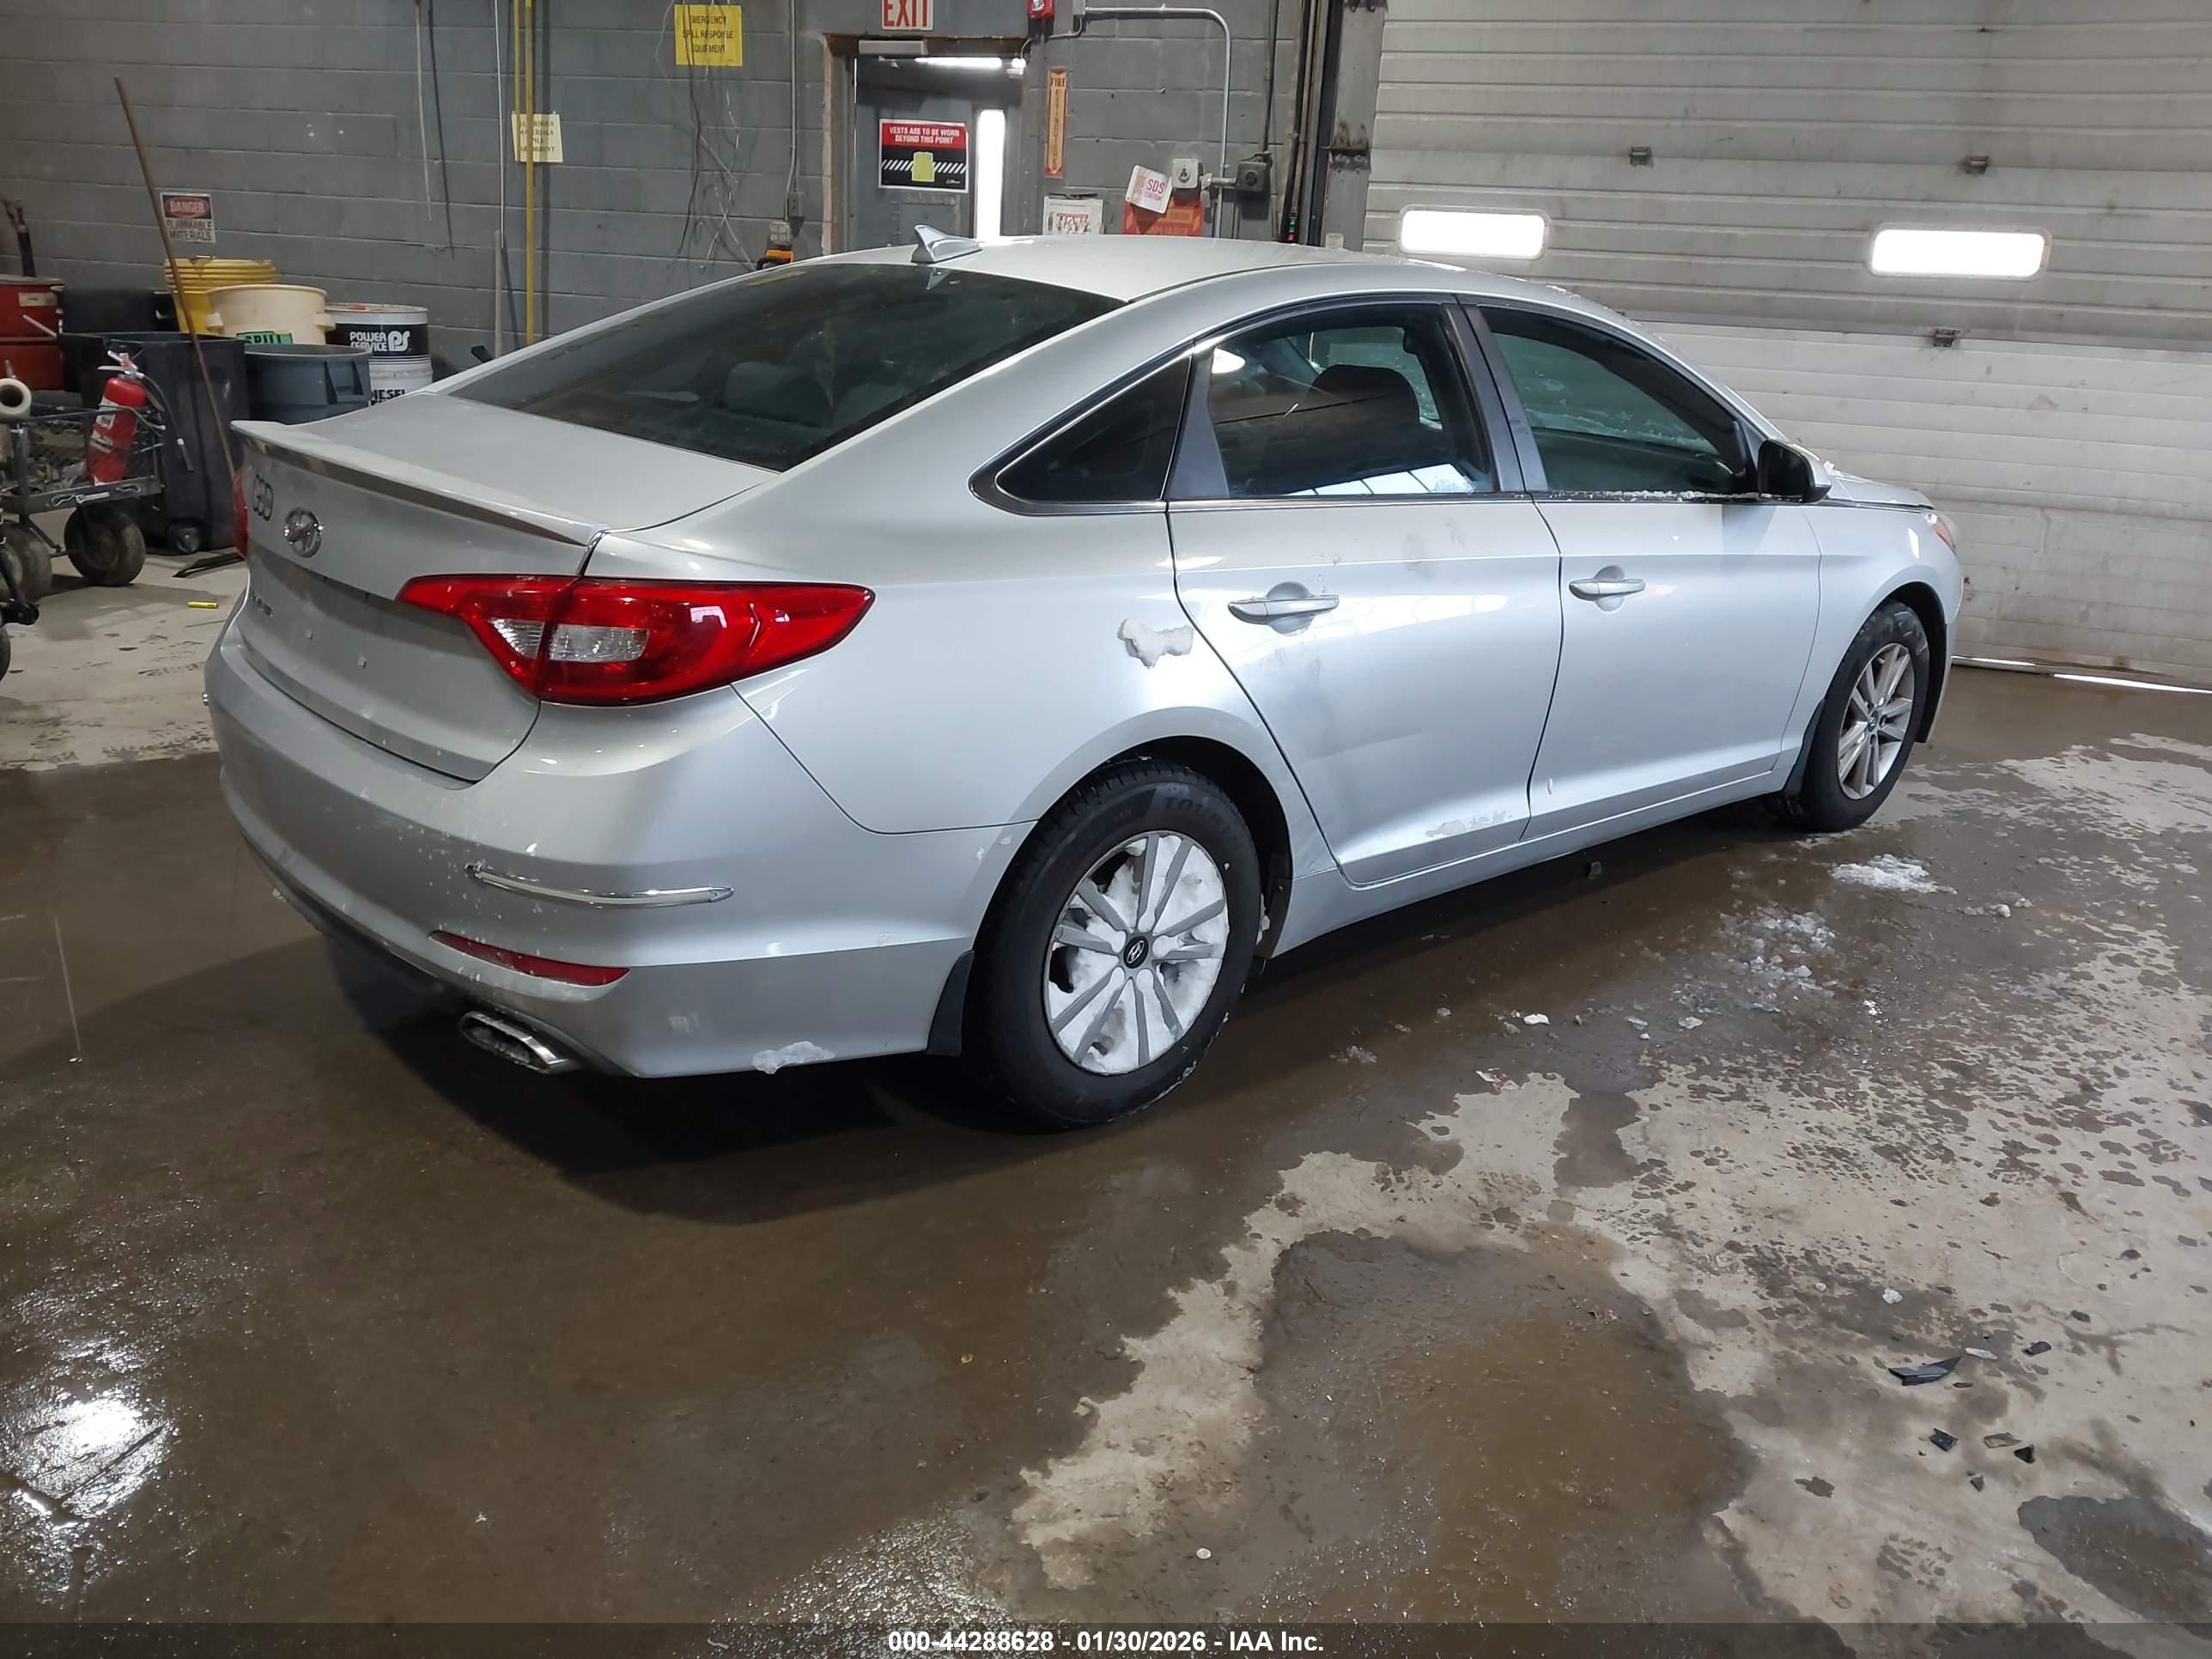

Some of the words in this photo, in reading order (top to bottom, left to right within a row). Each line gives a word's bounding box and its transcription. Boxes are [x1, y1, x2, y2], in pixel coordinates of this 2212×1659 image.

[883, 0, 927, 27] EXIT
[1050, 77, 1066, 87] FIRE
[895, 134, 919, 143] BEYOND
[935, 136, 954, 144] POINT
[1146, 178, 1165, 194] SDS
[170, 200, 205, 213] DANGER
[349, 331, 386, 342] POWER
